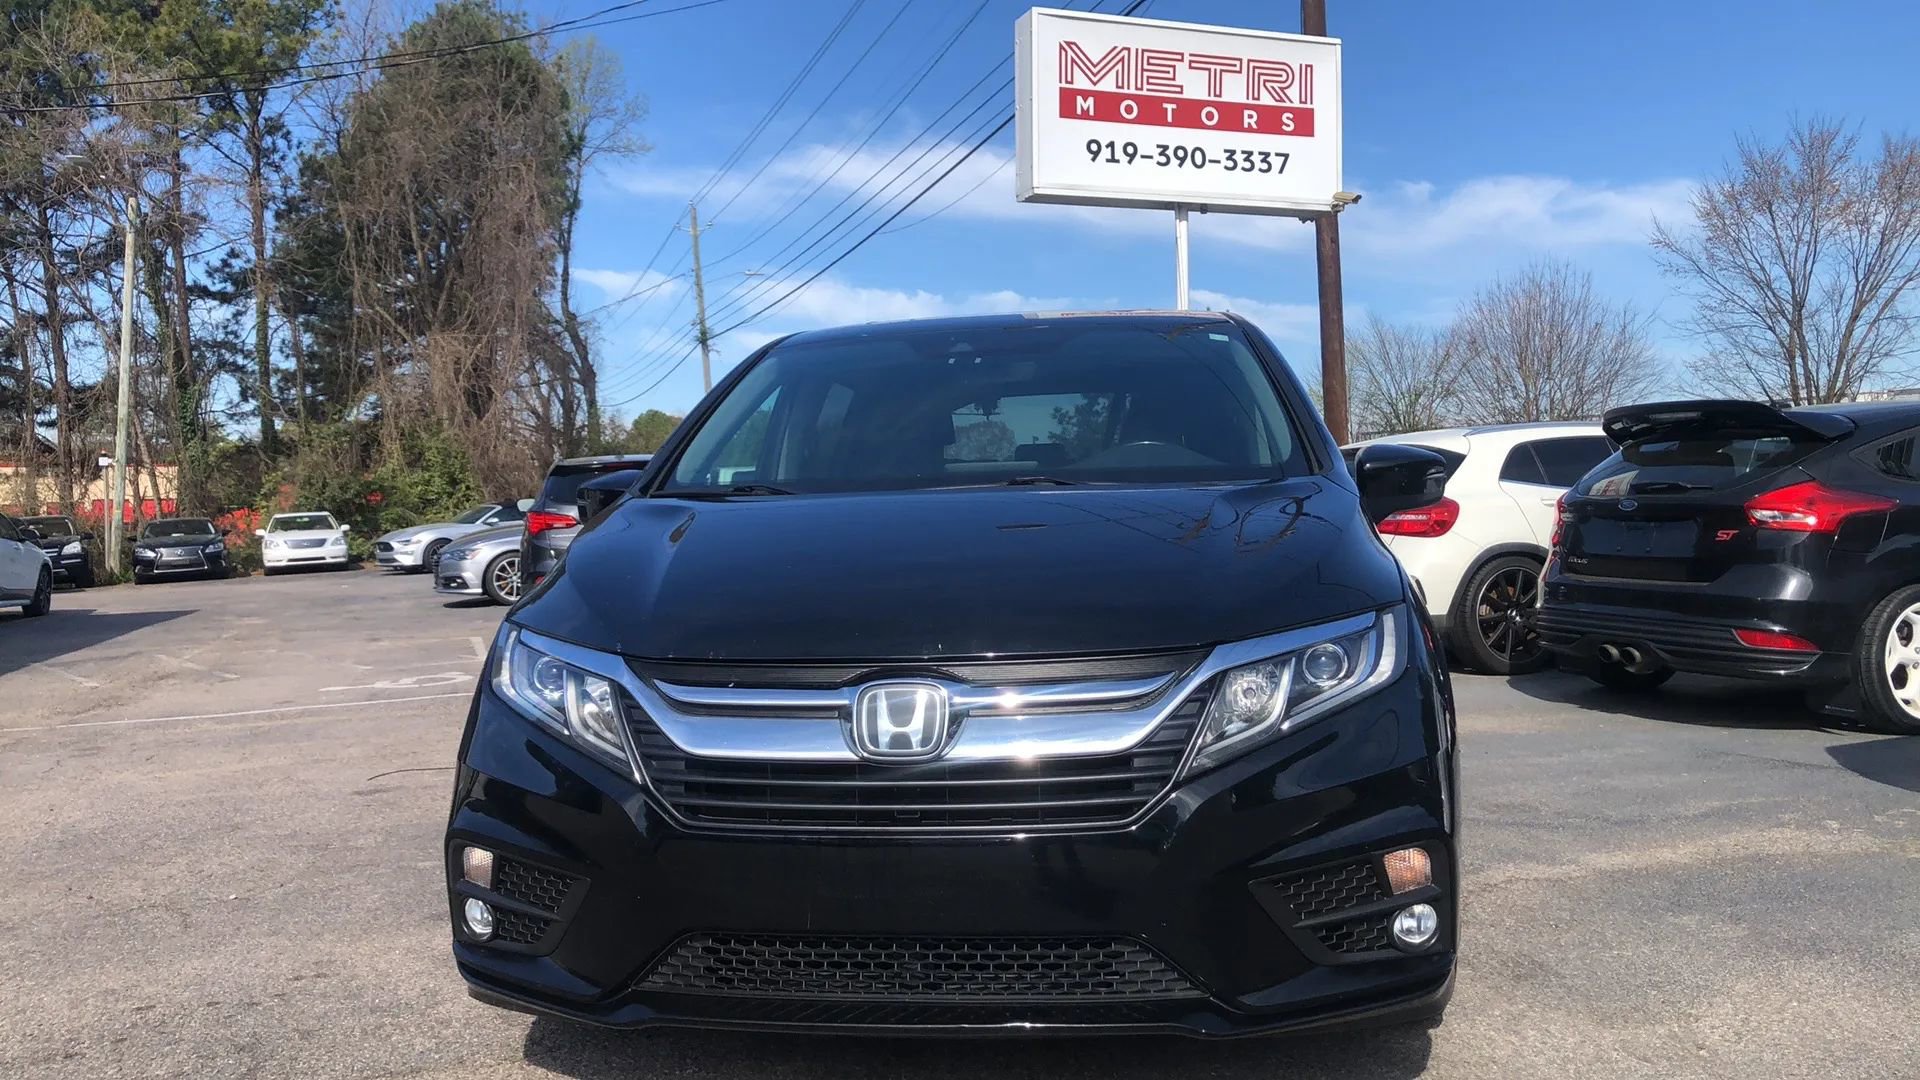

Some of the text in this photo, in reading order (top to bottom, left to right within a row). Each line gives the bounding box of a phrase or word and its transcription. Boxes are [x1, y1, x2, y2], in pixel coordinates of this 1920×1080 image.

[1058, 40, 1313, 105] METRI
[1076, 95, 1295, 132] MOTORS
[1086, 138, 1290, 174] 919-390-3337
[1715, 529, 1740, 541] ST
